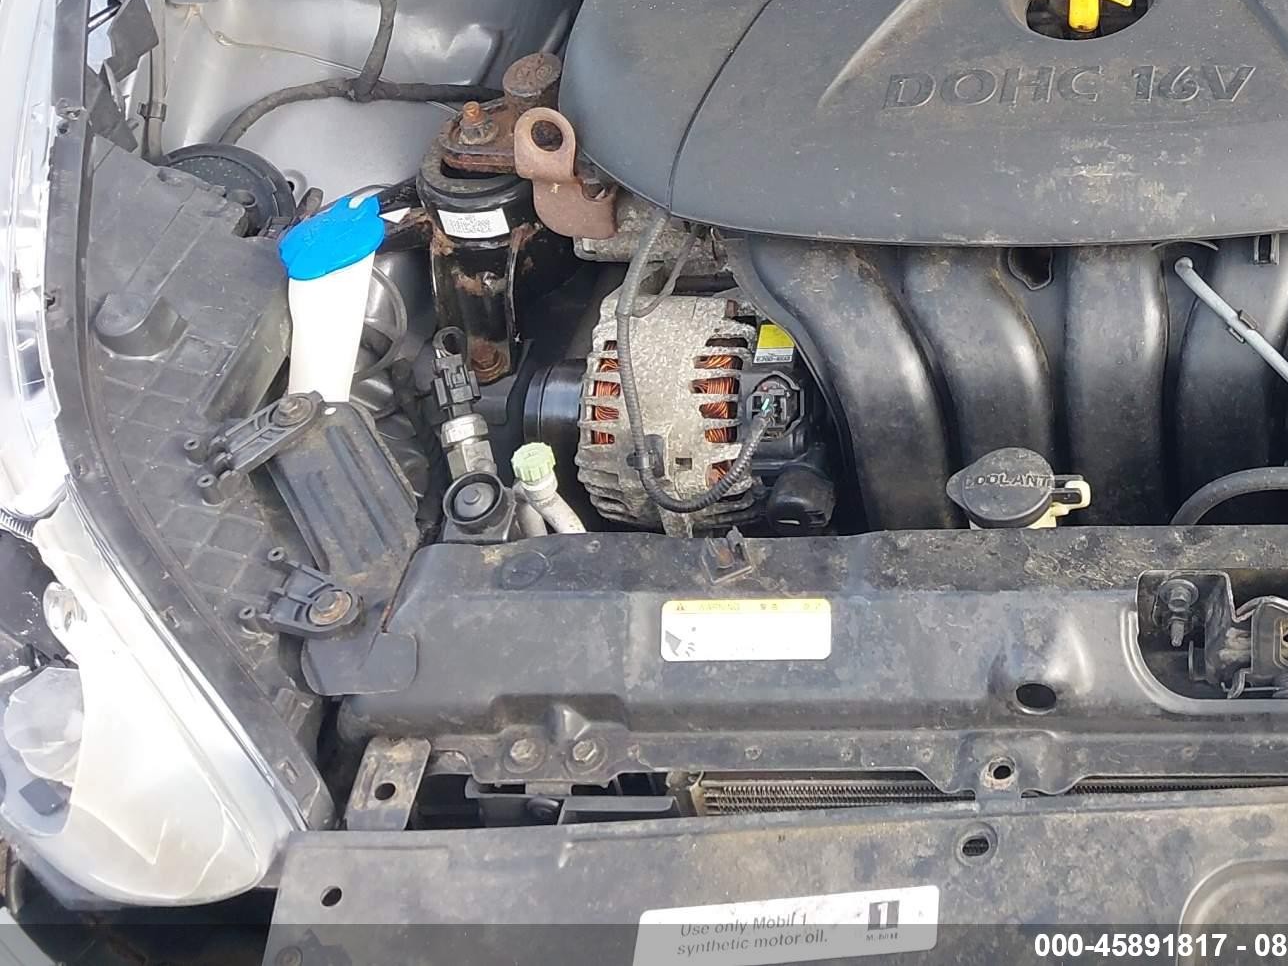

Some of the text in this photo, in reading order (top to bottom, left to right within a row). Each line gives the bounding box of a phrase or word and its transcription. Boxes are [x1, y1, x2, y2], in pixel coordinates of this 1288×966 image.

[883, 65, 1256, 110] DOHC 16V
[680, 922, 710, 938] Use
[714, 919, 748, 936] only
[677, 929, 828, 956] synthetic motor oil.
